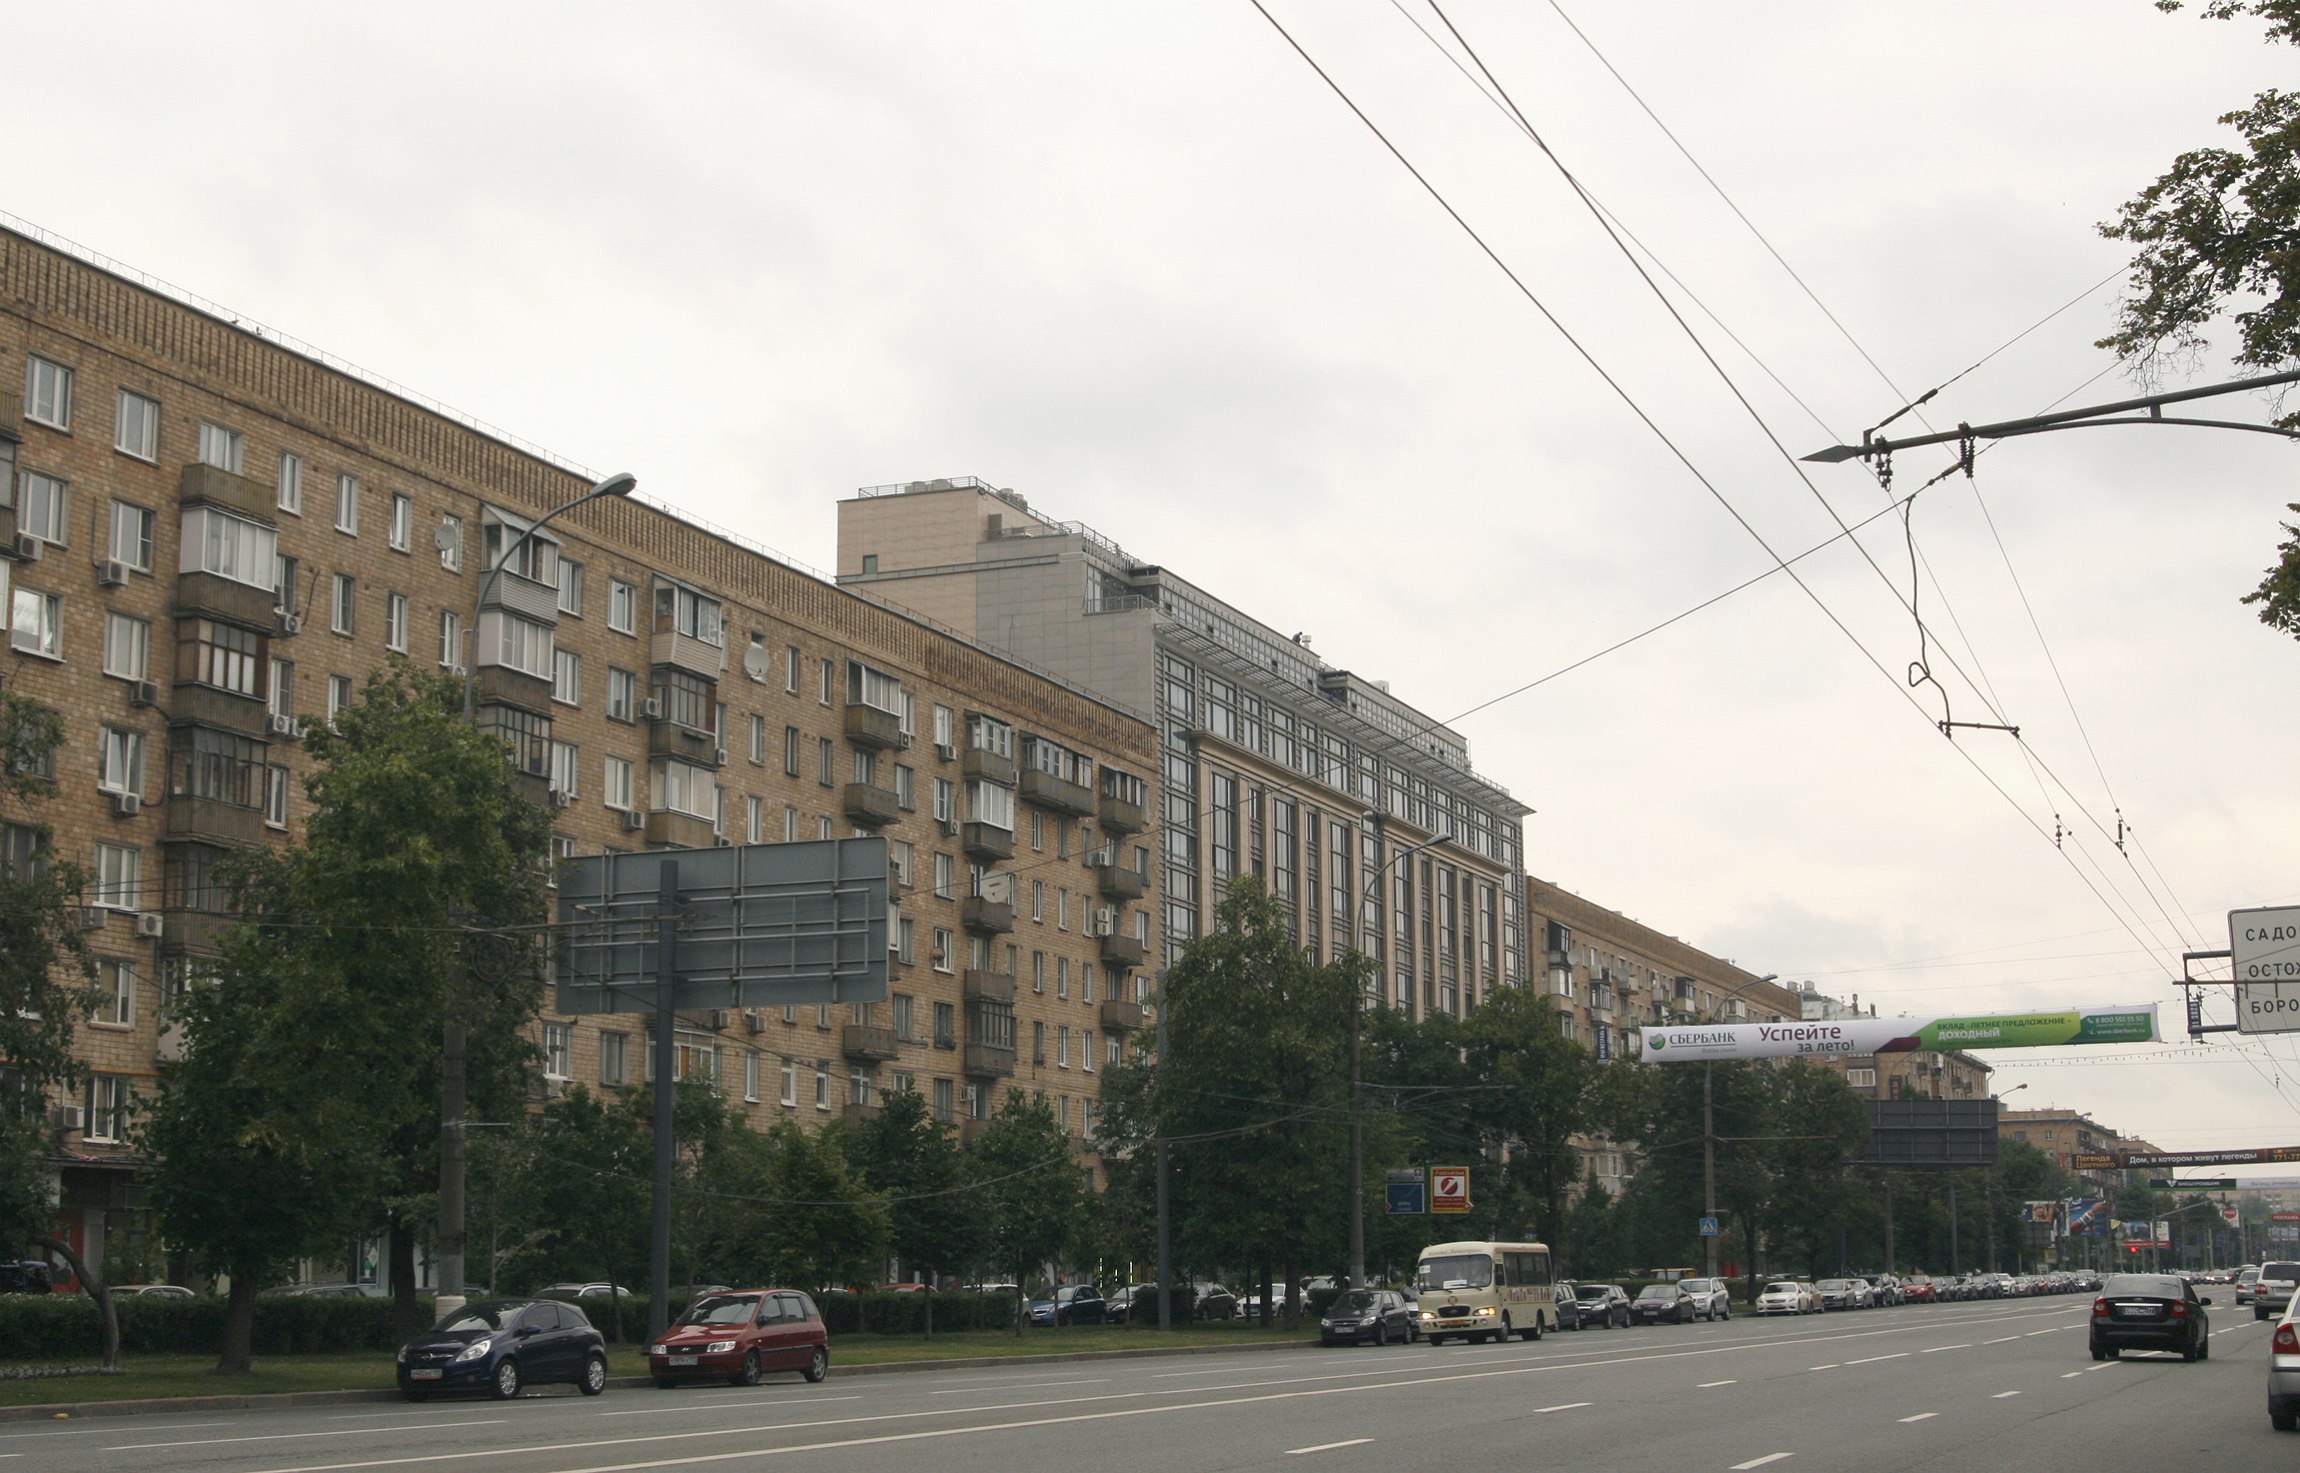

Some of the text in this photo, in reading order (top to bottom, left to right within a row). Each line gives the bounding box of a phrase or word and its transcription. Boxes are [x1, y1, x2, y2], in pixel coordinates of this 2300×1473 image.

[2245, 925, 2300, 942] САДО
[1937, 1022, 1965, 1031] ВКЛАД
[1970, 1019, 2001, 1029] ЛЕТНЕЕ
[2002, 1016, 2066, 1028] ПРЕДЛОЖЕНИЕ
[2100, 1016, 2114, 1024] 800
[1669, 1031, 1737, 1045] СБЕРБАНК
[1759, 1025, 1841, 1042] Успейте
[1938, 1027, 2001, 1041] ДОХОДНЫЙ
[1797, 1039, 1855, 1053] за лето!
[2076, 1154, 2111, 1163] Легенда
[2076, 1161, 2116, 1169] Цветного
[2129, 1156, 2150, 1165] Дом,
[2158, 1155, 2193, 1164] котором
[2194, 1153, 2220, 1163] живут
[2221, 1151, 2257, 1162] легенды
